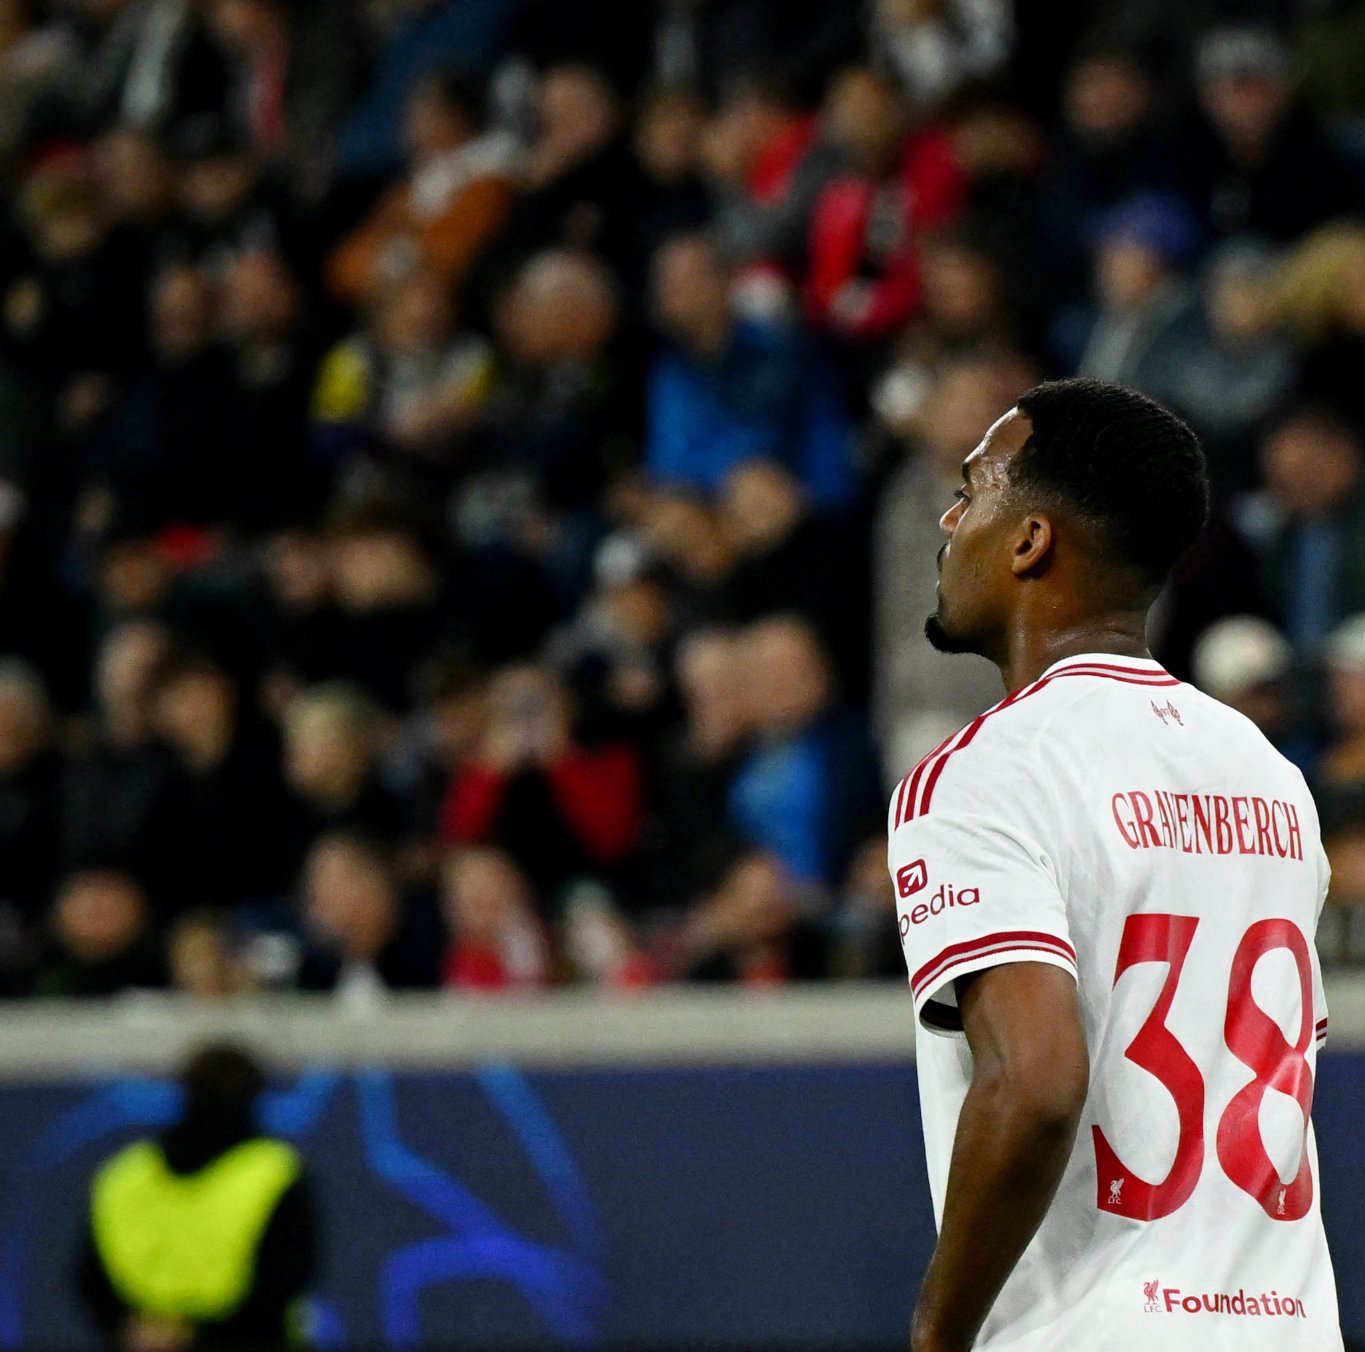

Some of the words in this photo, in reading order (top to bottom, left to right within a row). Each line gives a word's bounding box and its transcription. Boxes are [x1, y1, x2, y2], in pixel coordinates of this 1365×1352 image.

[1111, 790, 1303, 861] GRAVENBERCH
[1092, 914, 1314, 1222] 38
[1162, 1288, 1307, 1319] Foundation
